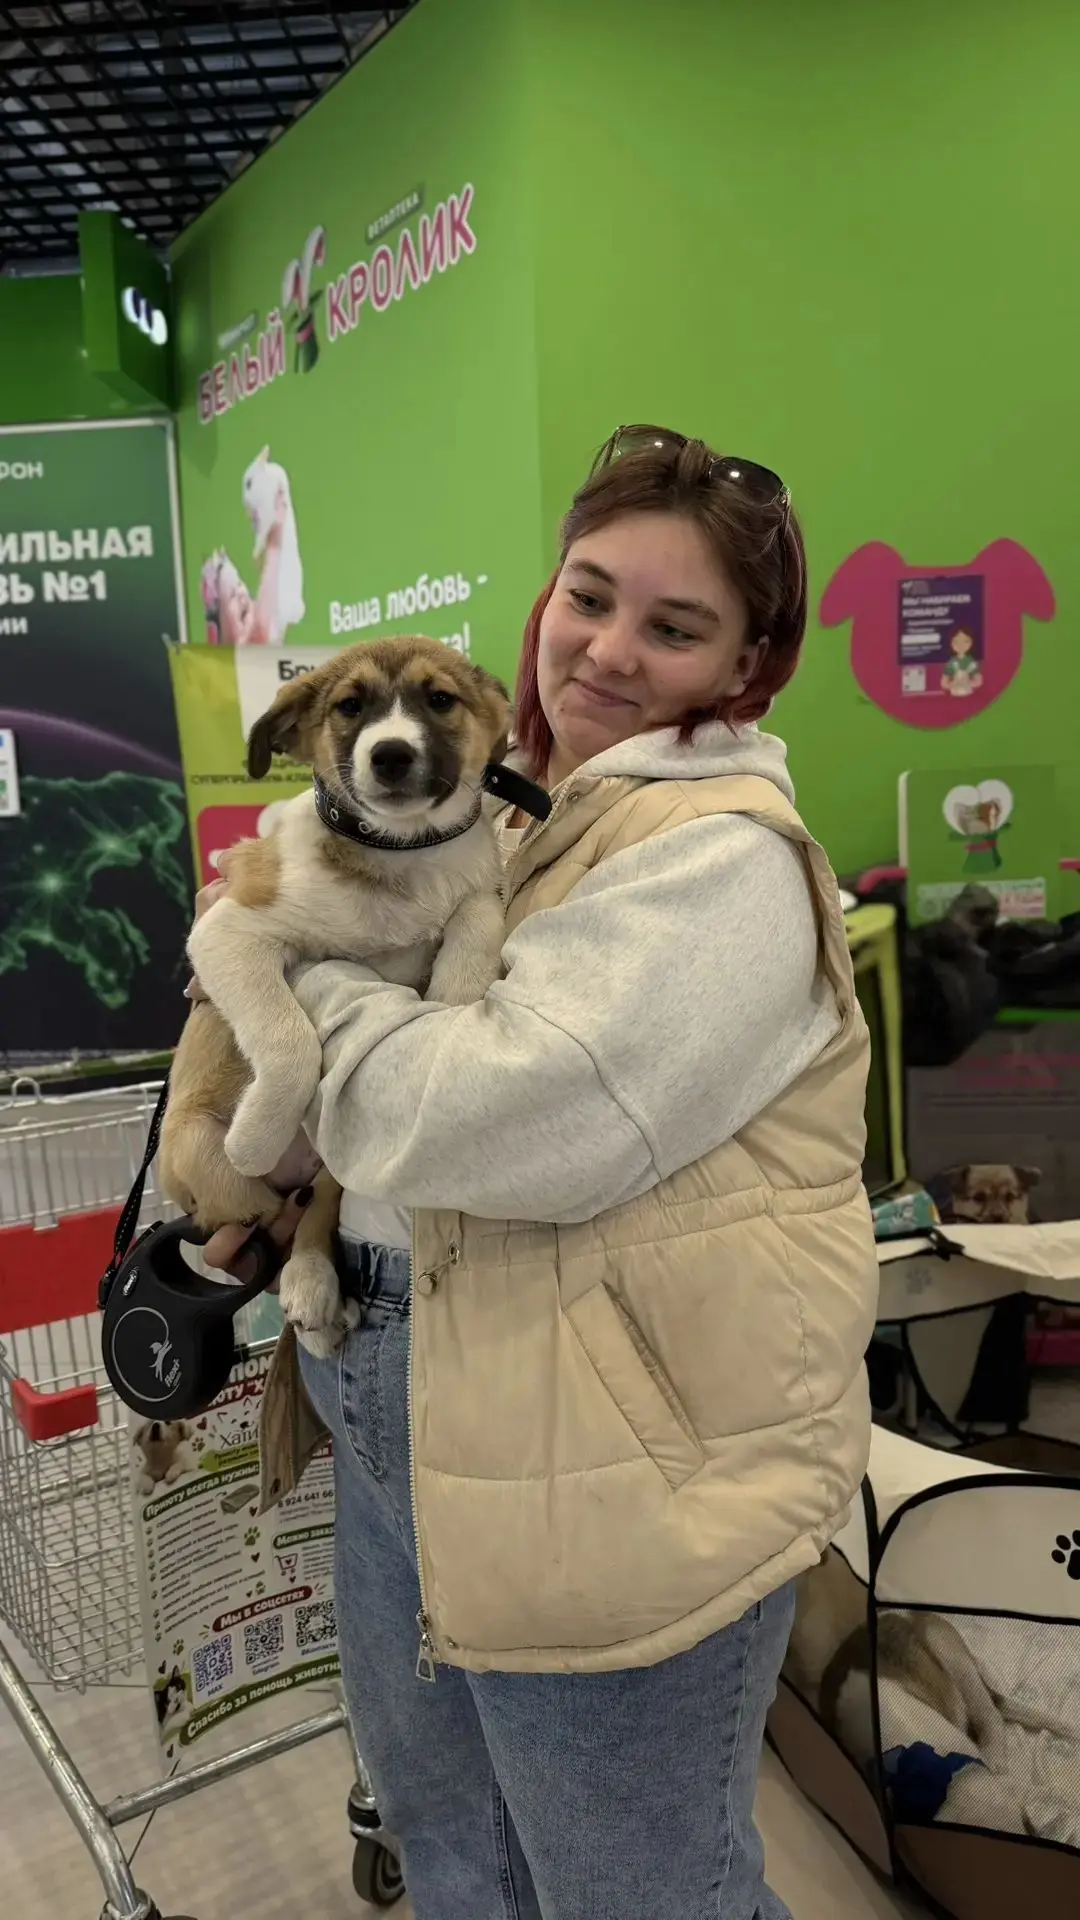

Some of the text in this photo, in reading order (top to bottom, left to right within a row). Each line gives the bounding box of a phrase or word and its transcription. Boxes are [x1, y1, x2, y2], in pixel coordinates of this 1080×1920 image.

[198, 182, 477, 424] БЕЛЫЙ КРОЛИК
[42, 569, 107, 603] №1
[329, 600, 380, 634] Ваша
[385, 572, 471, 621] любовь
[146, 1491, 185, 1517] Приюту
[186, 1477, 219, 1496] всегда
[220, 1611, 243, 1629] Мы
[254, 1590, 305, 1613] соцсетях
[187, 1701, 233, 1737] Спасибо
[235, 1694, 248, 1708] за
[250, 1677, 294, 1700] помощь
